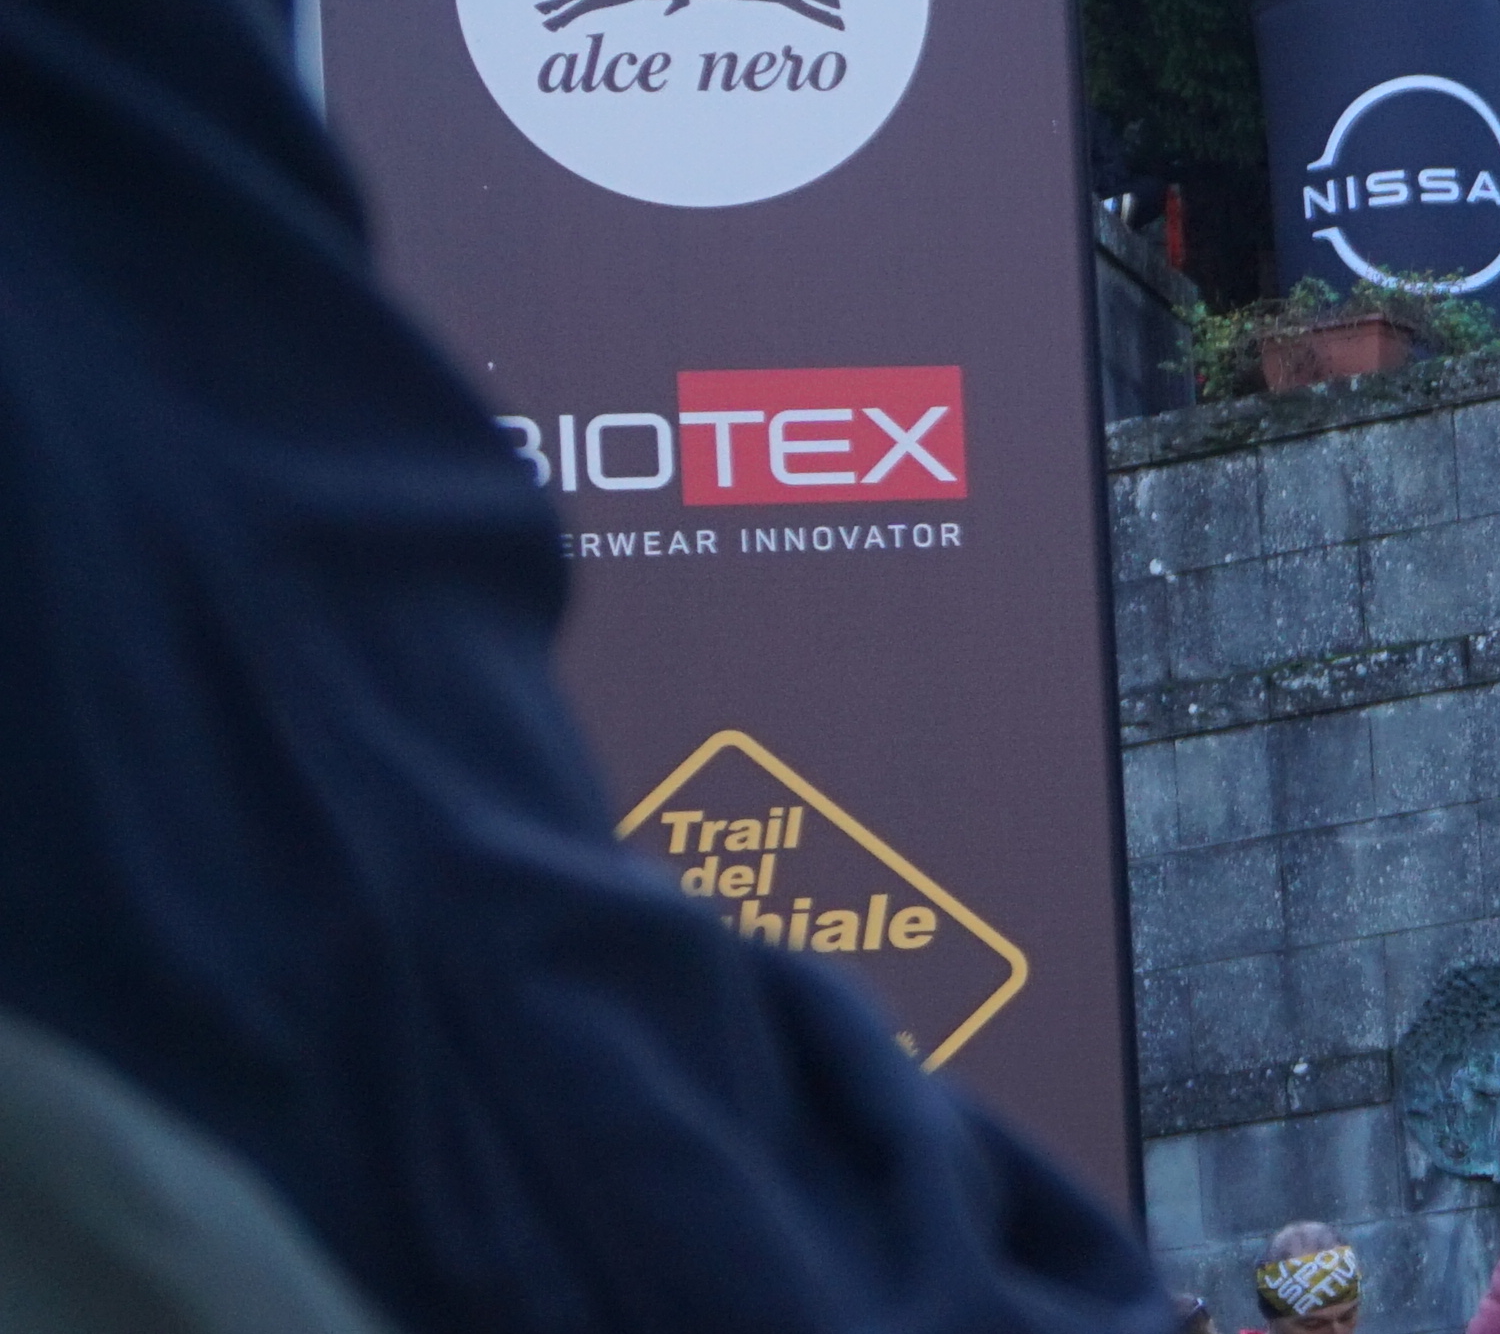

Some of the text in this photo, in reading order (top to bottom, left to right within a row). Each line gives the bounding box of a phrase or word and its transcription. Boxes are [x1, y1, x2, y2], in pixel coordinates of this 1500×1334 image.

[537, 33, 848, 93] alce nero
[558, 521, 964, 559] ERWEAR INNOVATOR
[659, 805, 804, 856] Trail
[679, 852, 777, 899] del
